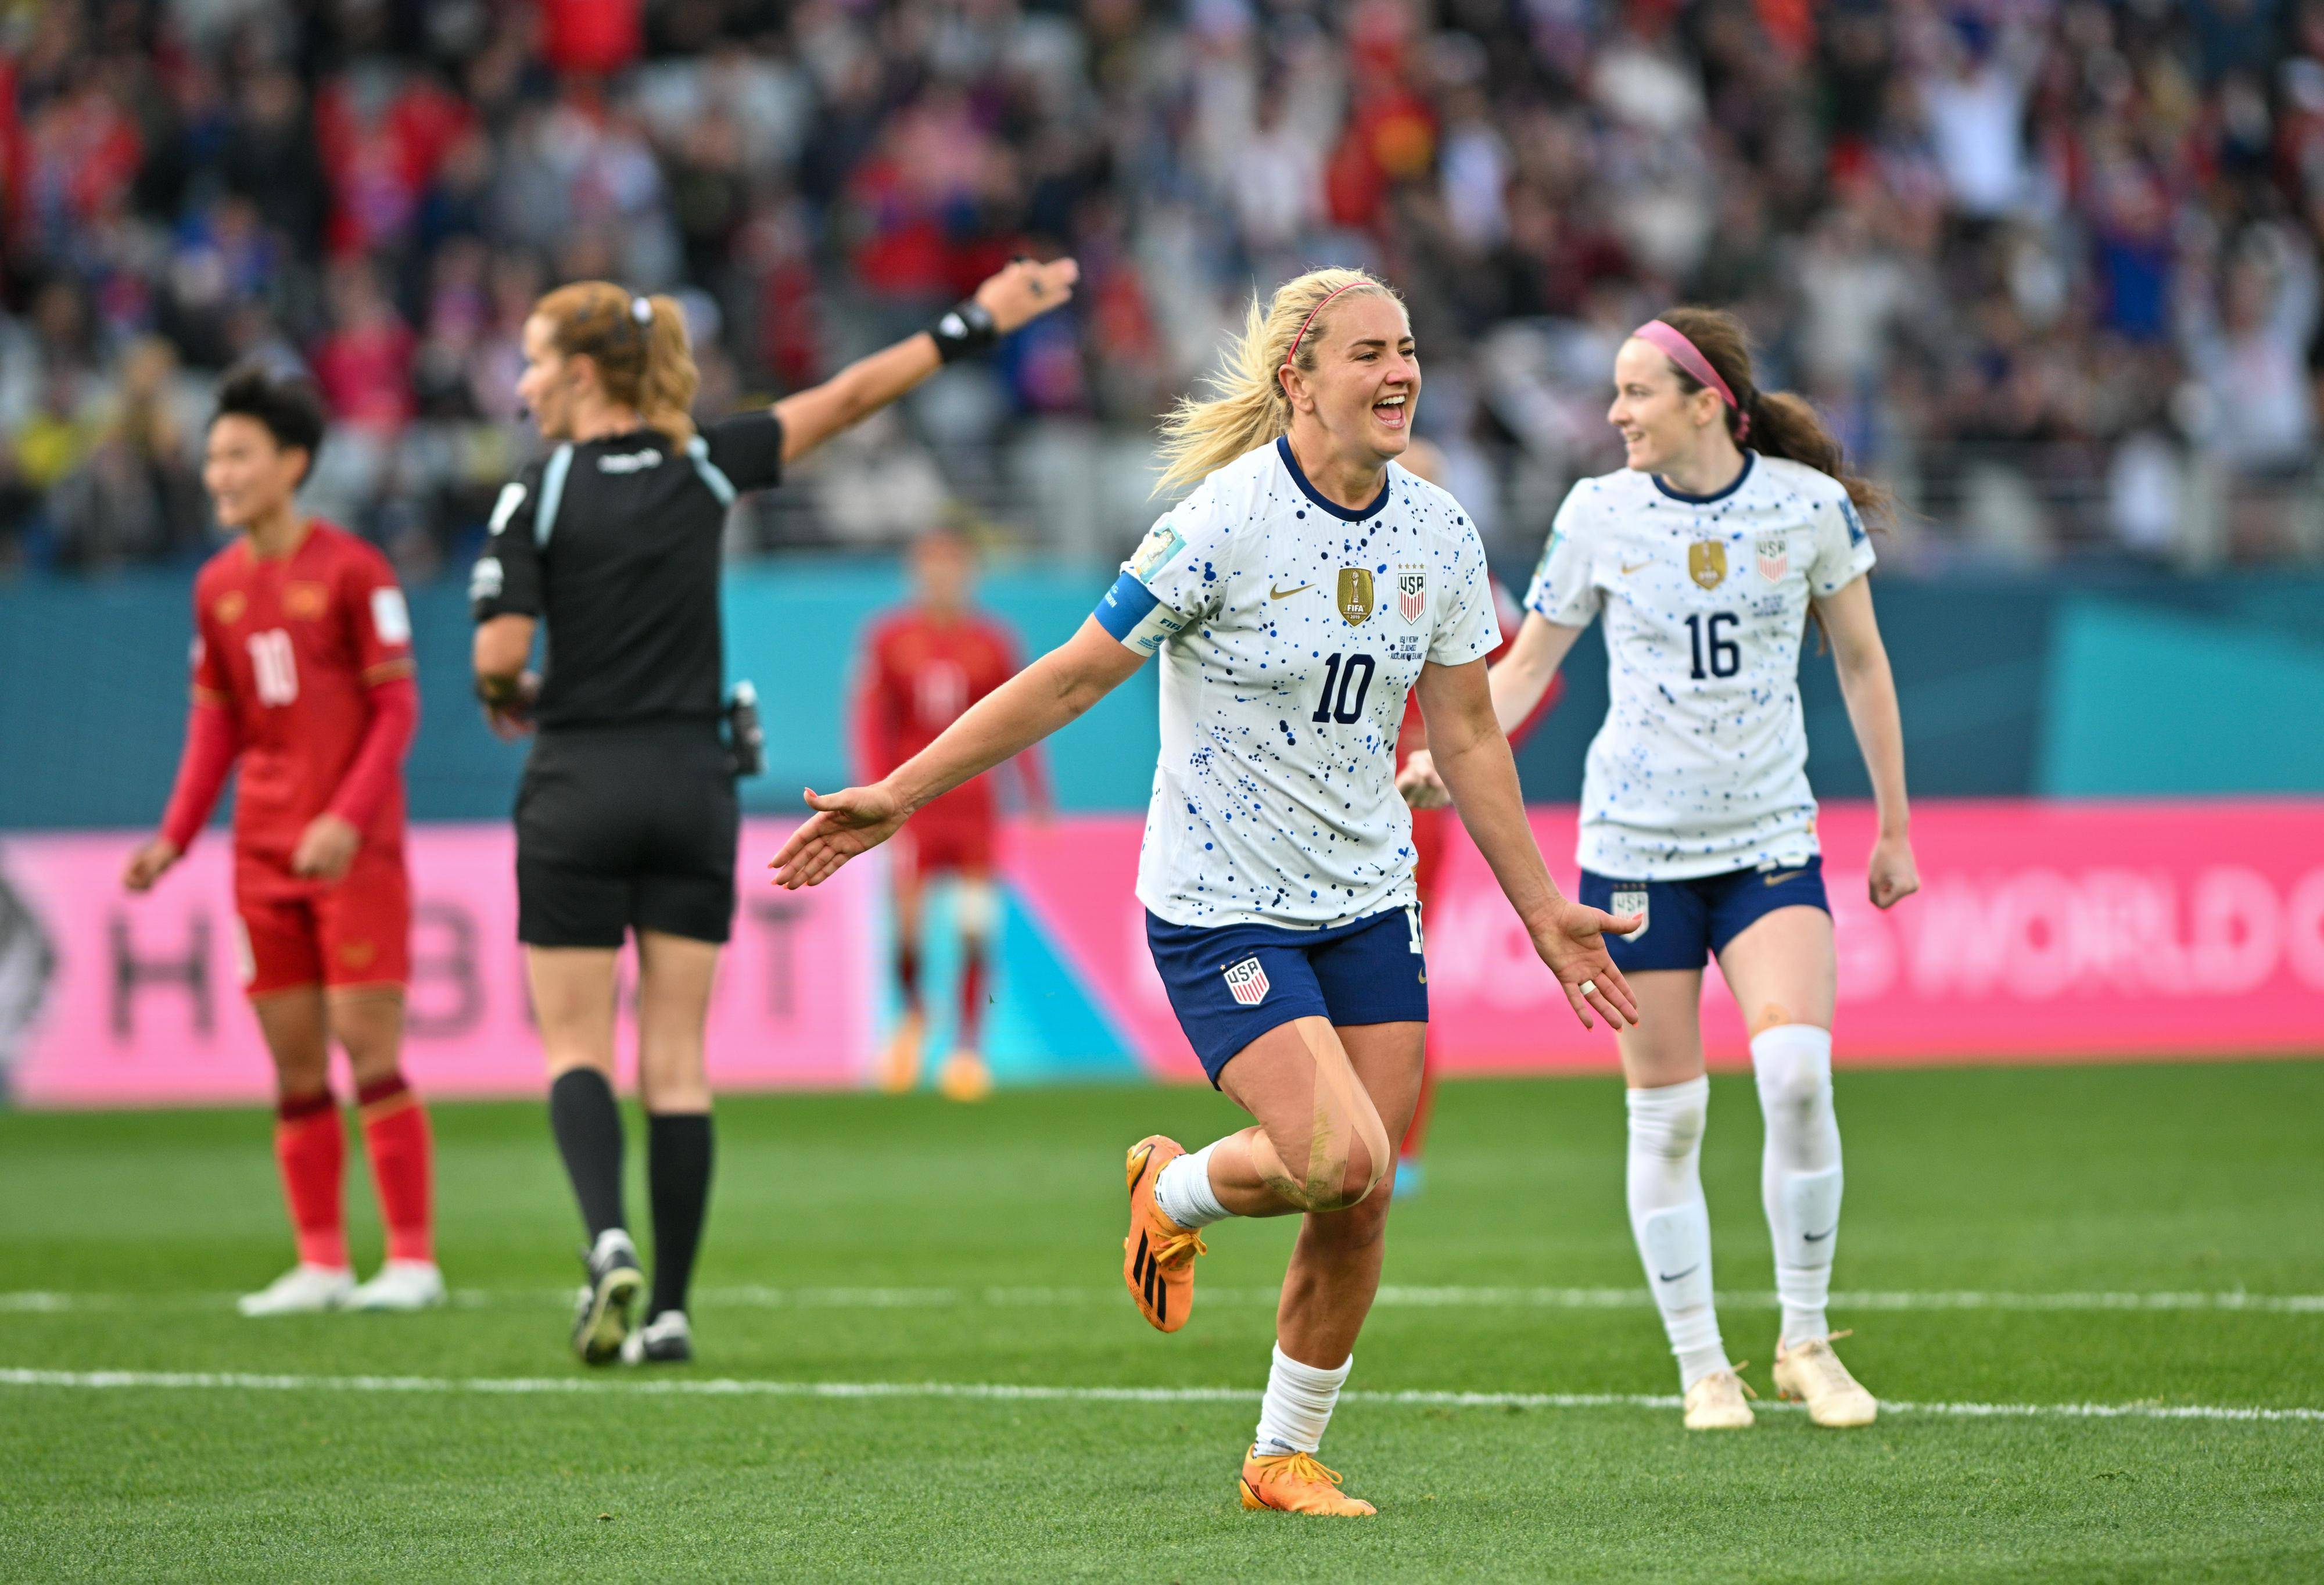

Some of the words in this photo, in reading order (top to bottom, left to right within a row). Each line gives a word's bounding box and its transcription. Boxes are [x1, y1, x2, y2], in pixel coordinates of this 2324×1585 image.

[1759, 540, 1785, 557] USA
[1400, 576, 1423, 595] USA
[1160, 618, 1182, 630] FIFA
[1684, 612, 1740, 679] 16
[247, 627, 299, 707] 10
[1312, 652, 1376, 725] 10
[1617, 892, 1645, 913] USA
[1905, 865, 2281, 1001] WORLD
[1227, 959, 1259, 984] USA
